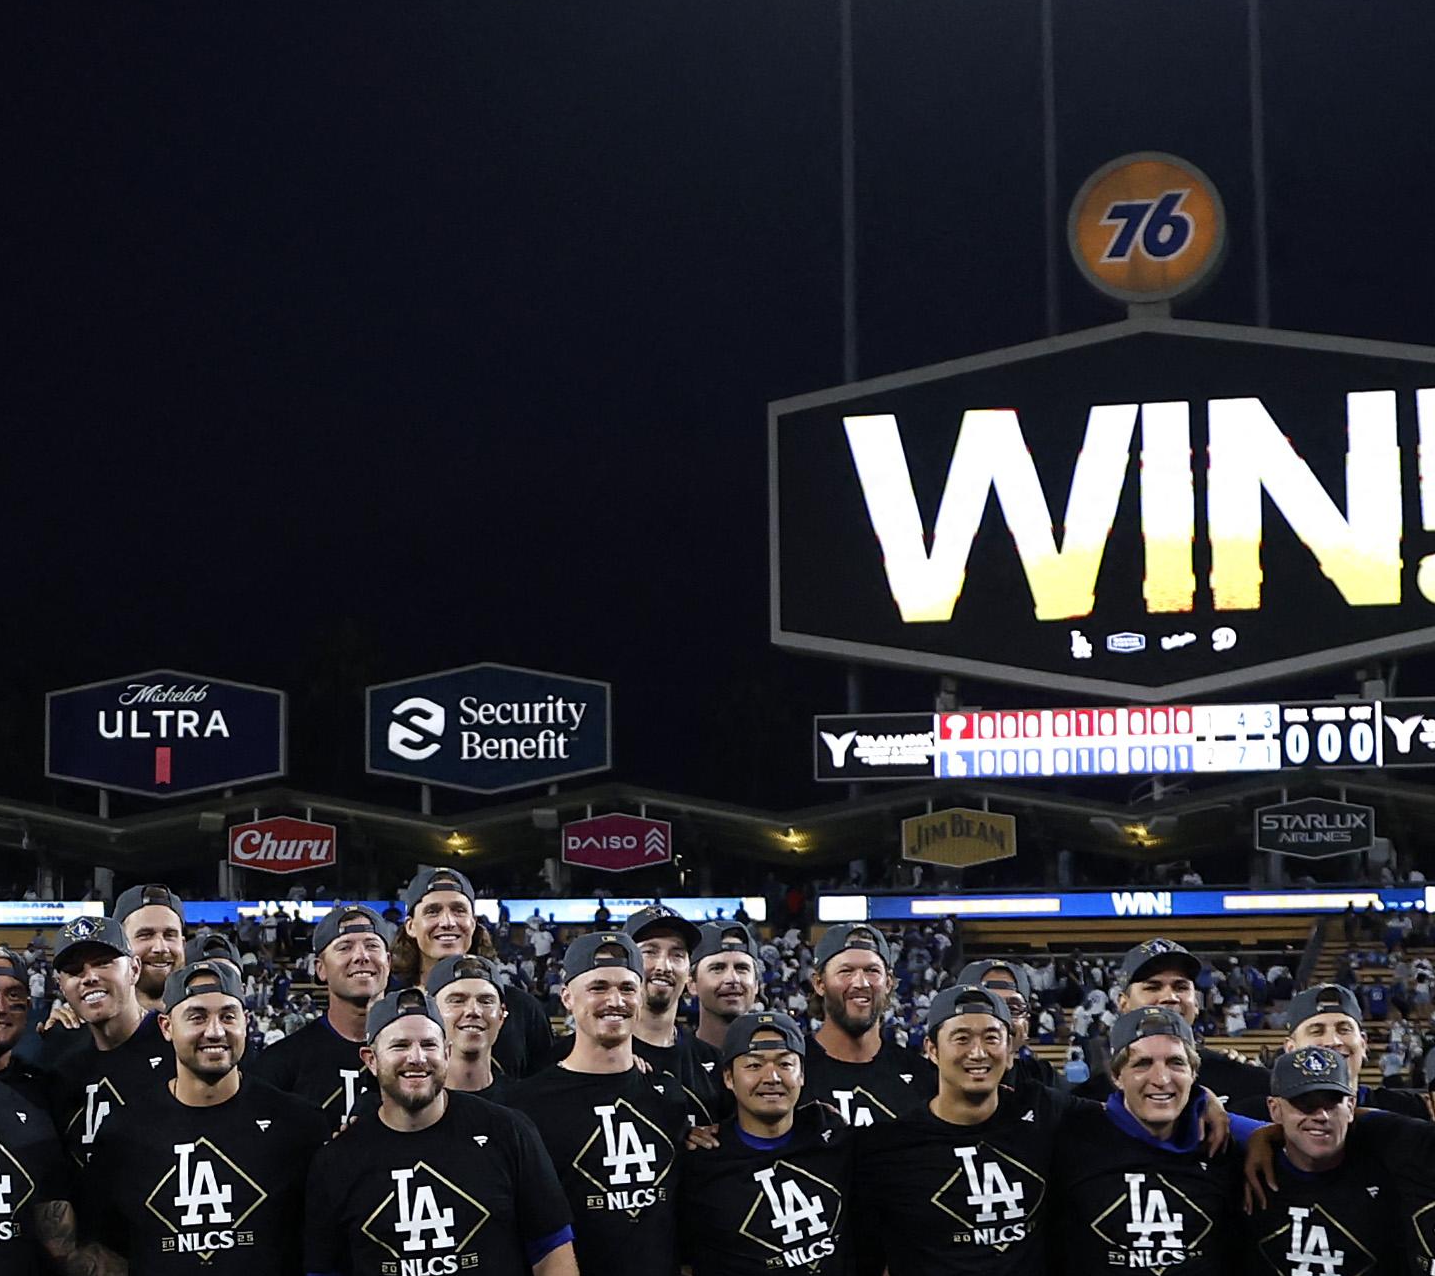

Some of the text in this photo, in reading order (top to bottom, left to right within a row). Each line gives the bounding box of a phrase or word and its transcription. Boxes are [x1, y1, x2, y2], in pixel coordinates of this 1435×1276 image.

[1099, 189, 1195, 263] 76
[119, 684, 209, 705] Michelob
[99, 710, 229, 738] ULTRA
[460, 695, 586, 730] Security
[1237, 712, 1246, 728] 4
[1264, 711, 1272, 728] 3
[461, 730, 569, 759] Benefit
[1239, 747, 1246, 763] 7
[1285, 724, 1310, 763] 0
[1318, 724, 1342, 763] 0
[1350, 723, 1373, 762] 0
[910, 817, 1007, 852] JIM BEAM
[1262, 813, 1366, 829] STARLUX
[234, 831, 331, 862] Churu
[1279, 831, 1351, 842] AIRLINES
[1112, 892, 1171, 915] WIN!
[593, 1105, 657, 1186] LA
[174, 1143, 234, 1225] LA
[607, 1188, 656, 1210] NLCS
[953, 1147, 1026, 1222] LA
[389, 1168, 455, 1252] LA
[753, 1166, 829, 1245] LA
[1125, 1173, 1185, 1248] LA
[178, 1231, 234, 1252] NLCS
[974, 1223, 1025, 1247] NLCS
[782, 1236, 834, 1269] NLCS
[1129, 1250, 1185, 1267] NLCS
